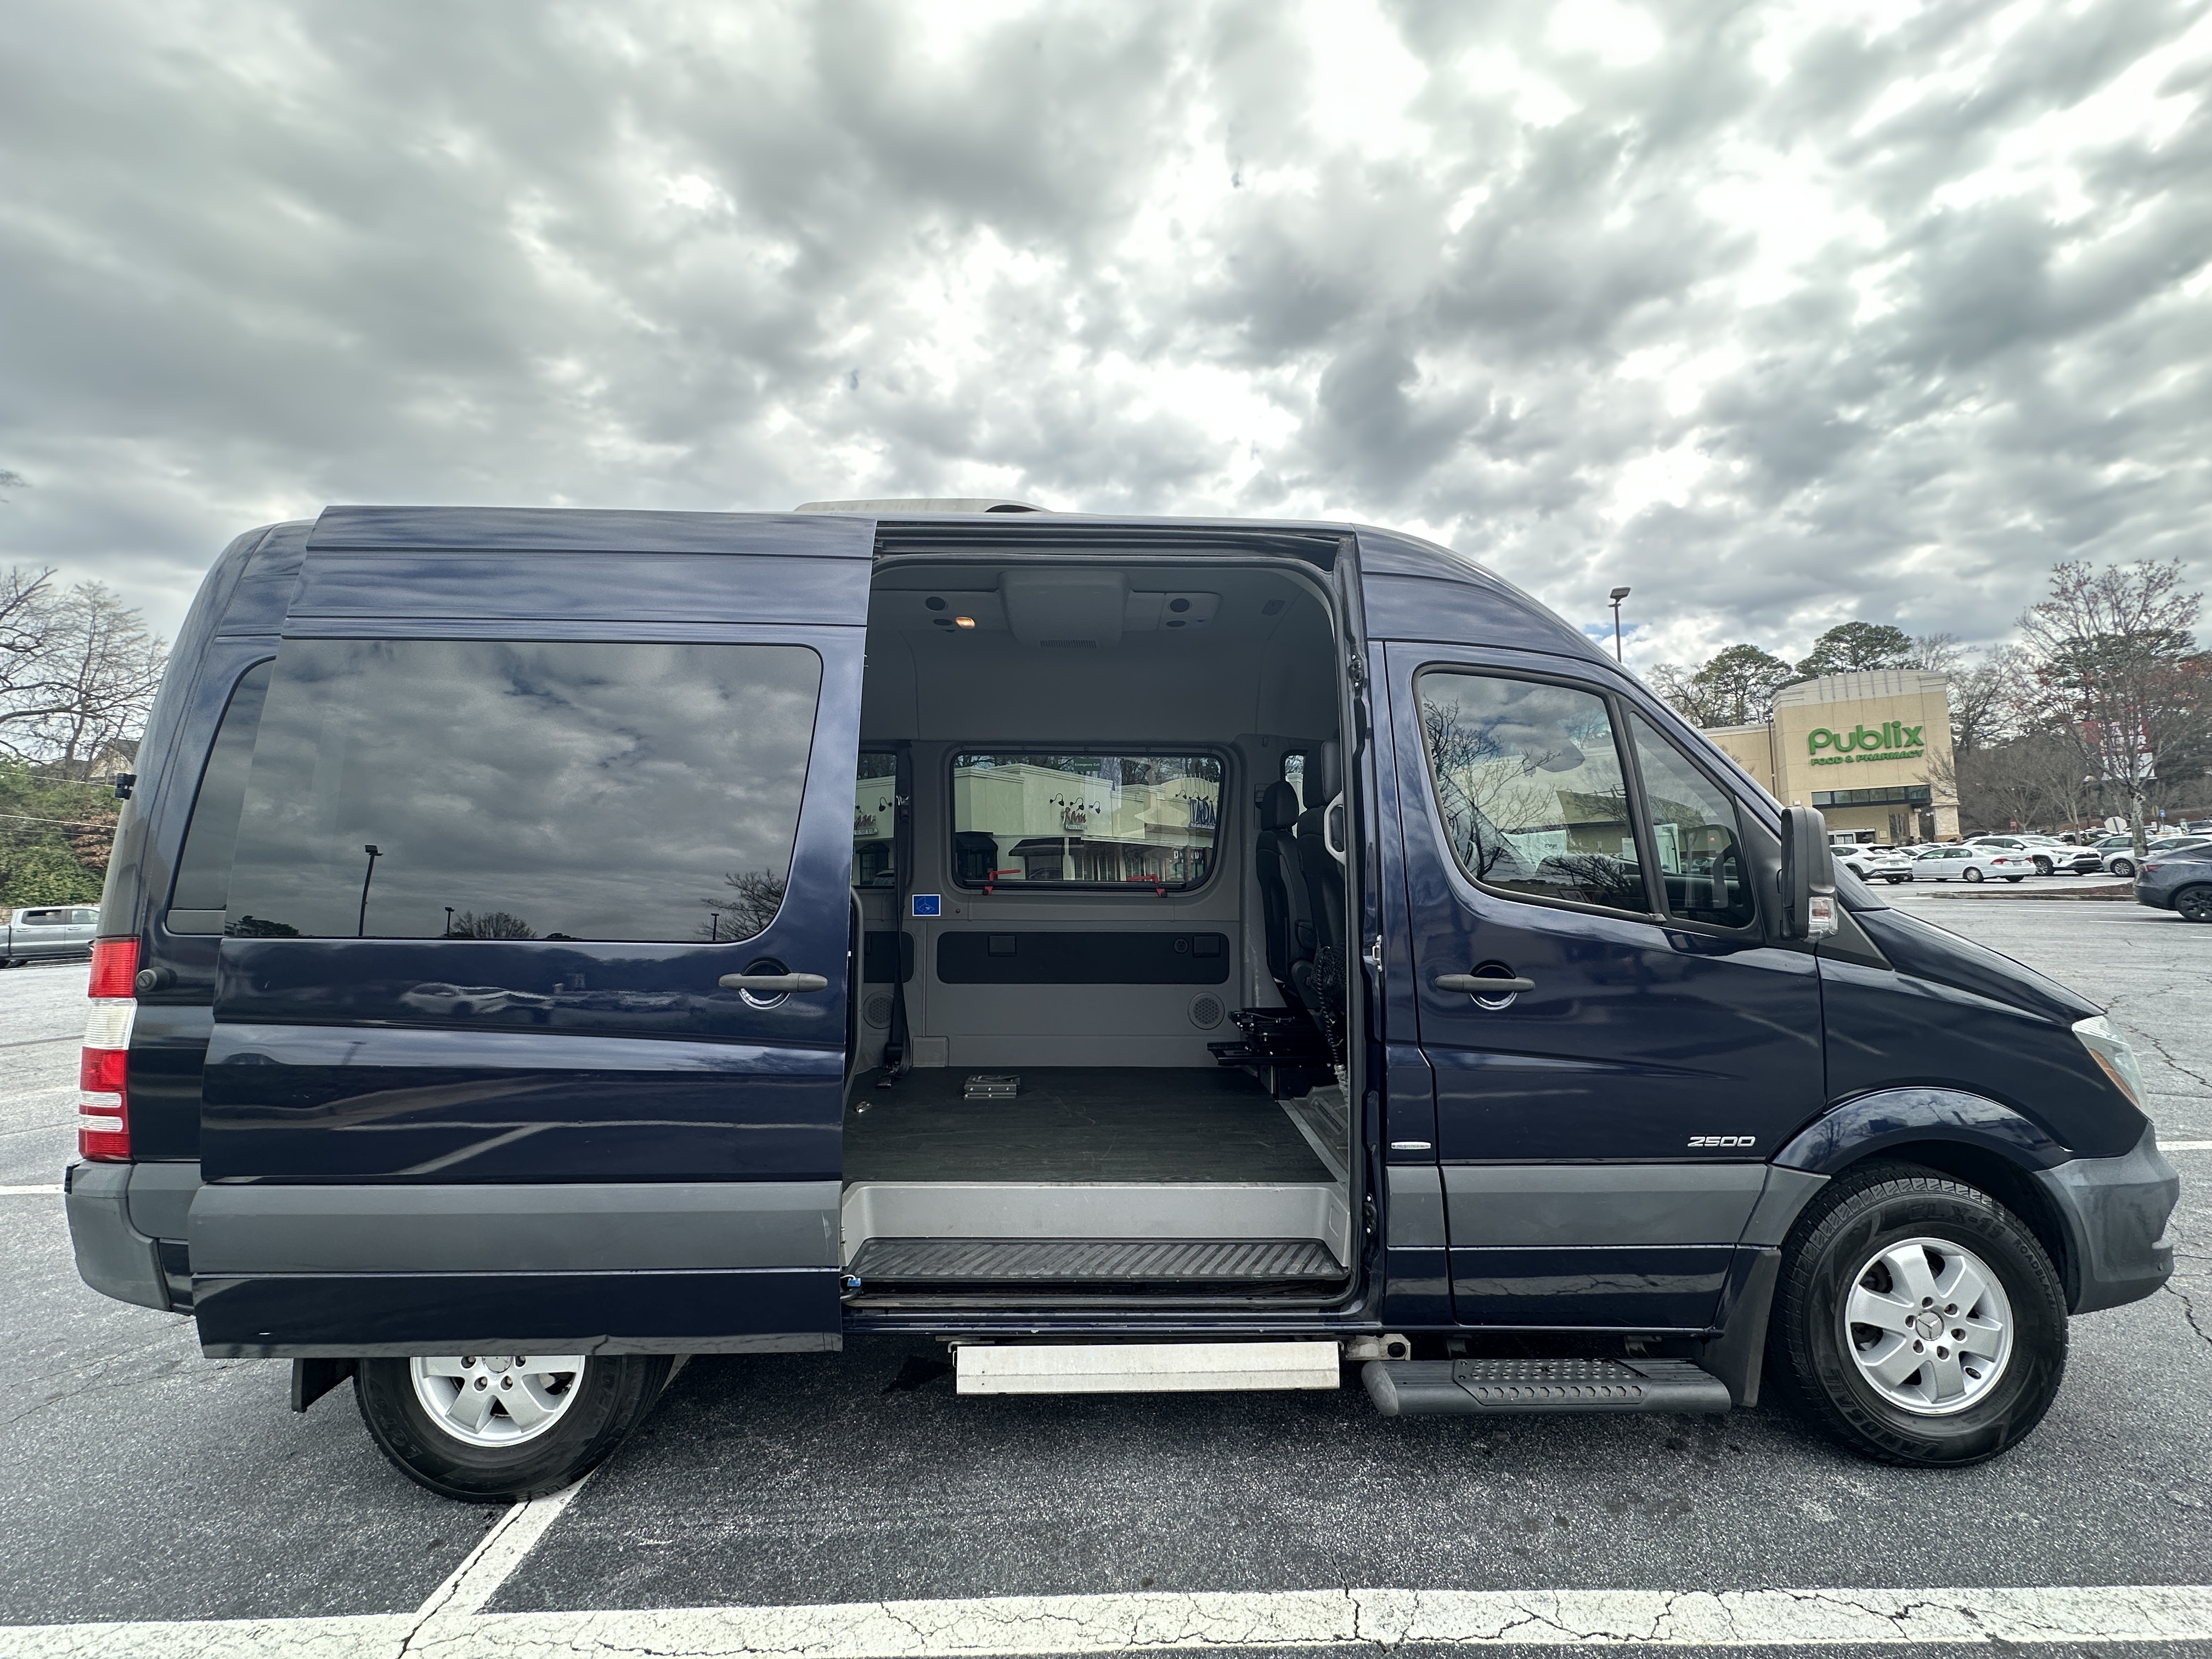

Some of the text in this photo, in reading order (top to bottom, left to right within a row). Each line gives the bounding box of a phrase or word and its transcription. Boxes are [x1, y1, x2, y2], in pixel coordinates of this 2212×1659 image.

[1808, 720, 1925, 754] Publix
[1811, 749, 1925, 765] FOOD & PHARMACY
[1688, 1136, 1756, 1147] 2500
